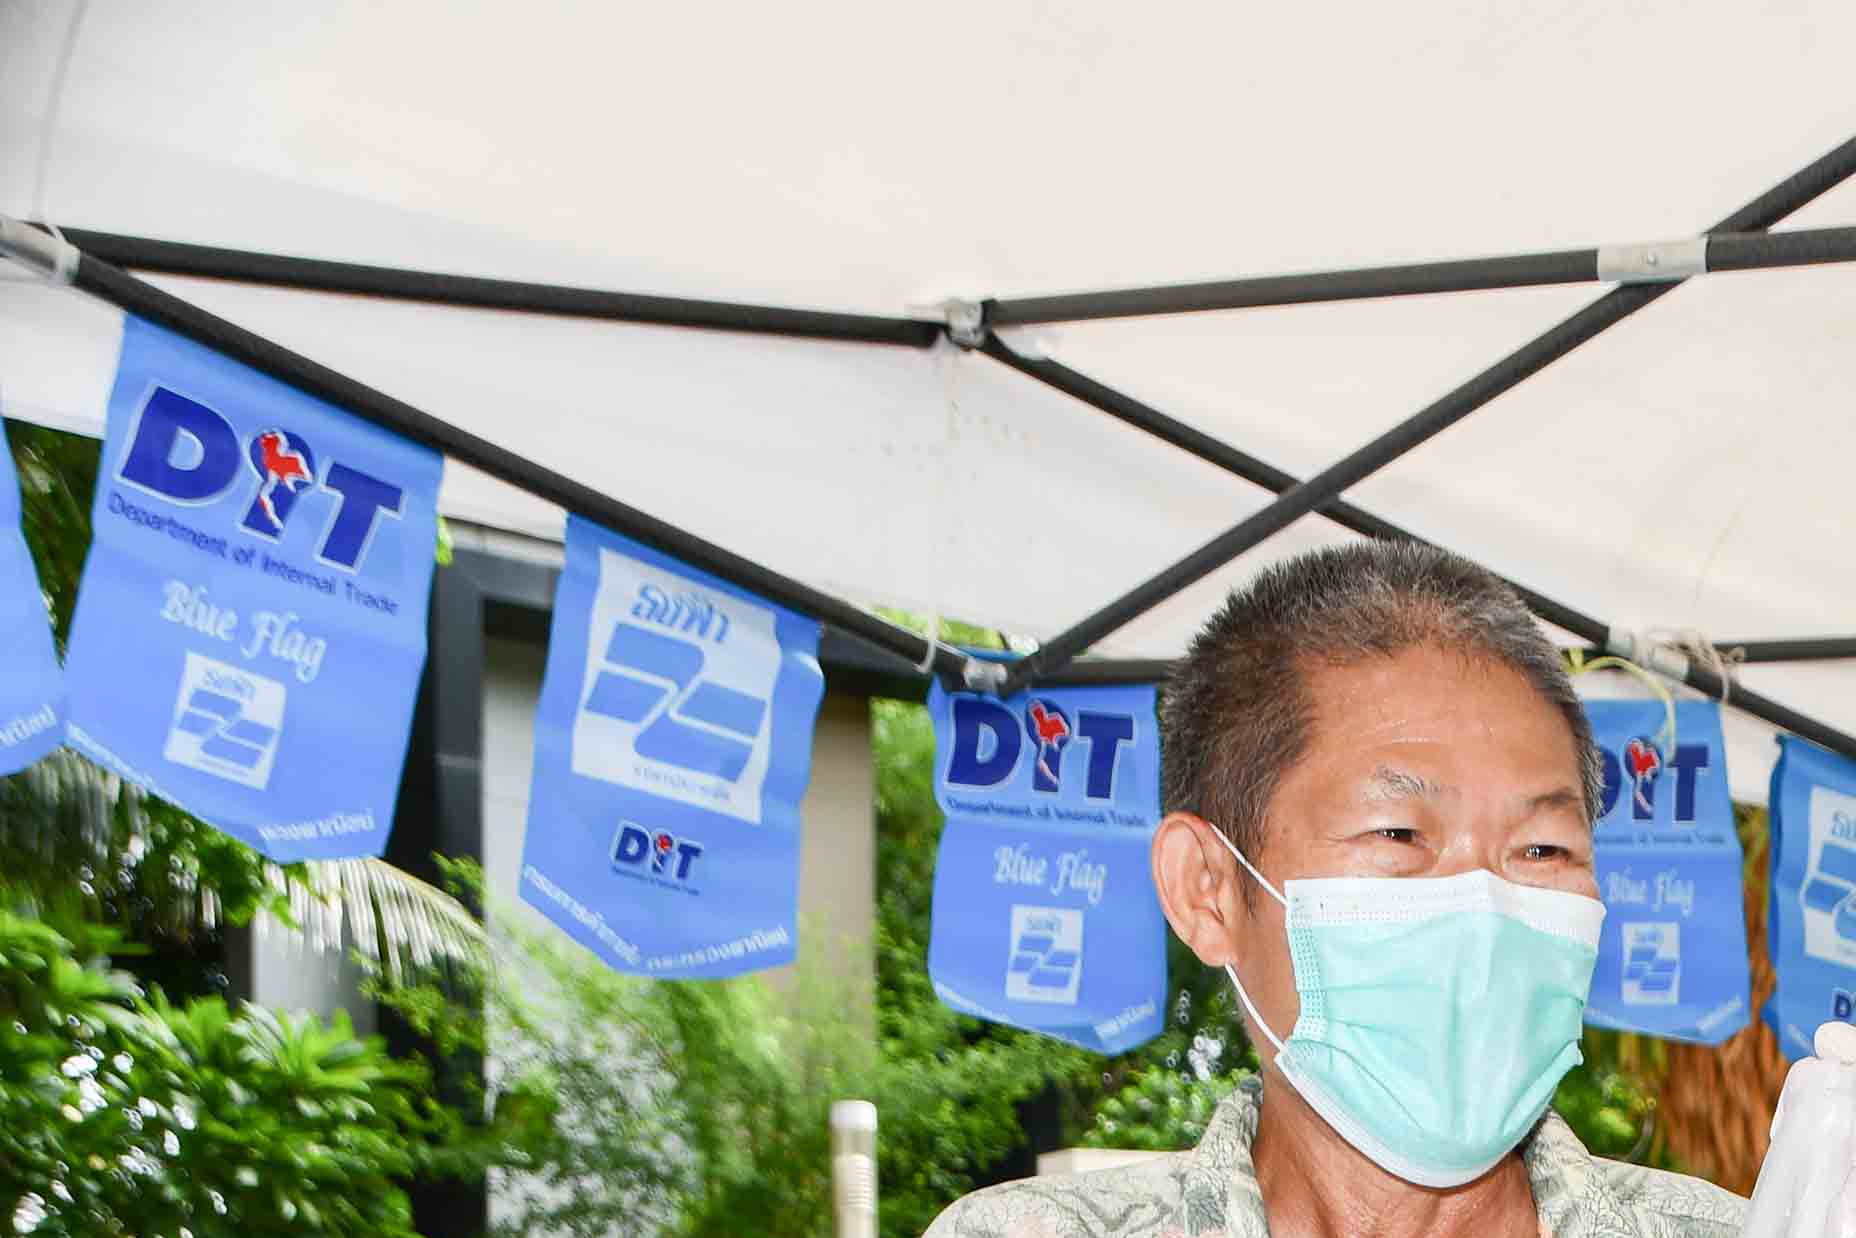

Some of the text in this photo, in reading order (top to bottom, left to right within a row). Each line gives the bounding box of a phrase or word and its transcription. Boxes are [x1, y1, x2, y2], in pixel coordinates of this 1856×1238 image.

[108, 492, 399, 615] Department of Internal Trade
[159, 579, 327, 683] Blue Flag
[946, 697, 1136, 800] DIT
[614, 823, 703, 881] DIT
[994, 842, 1109, 906] Blue Flag
